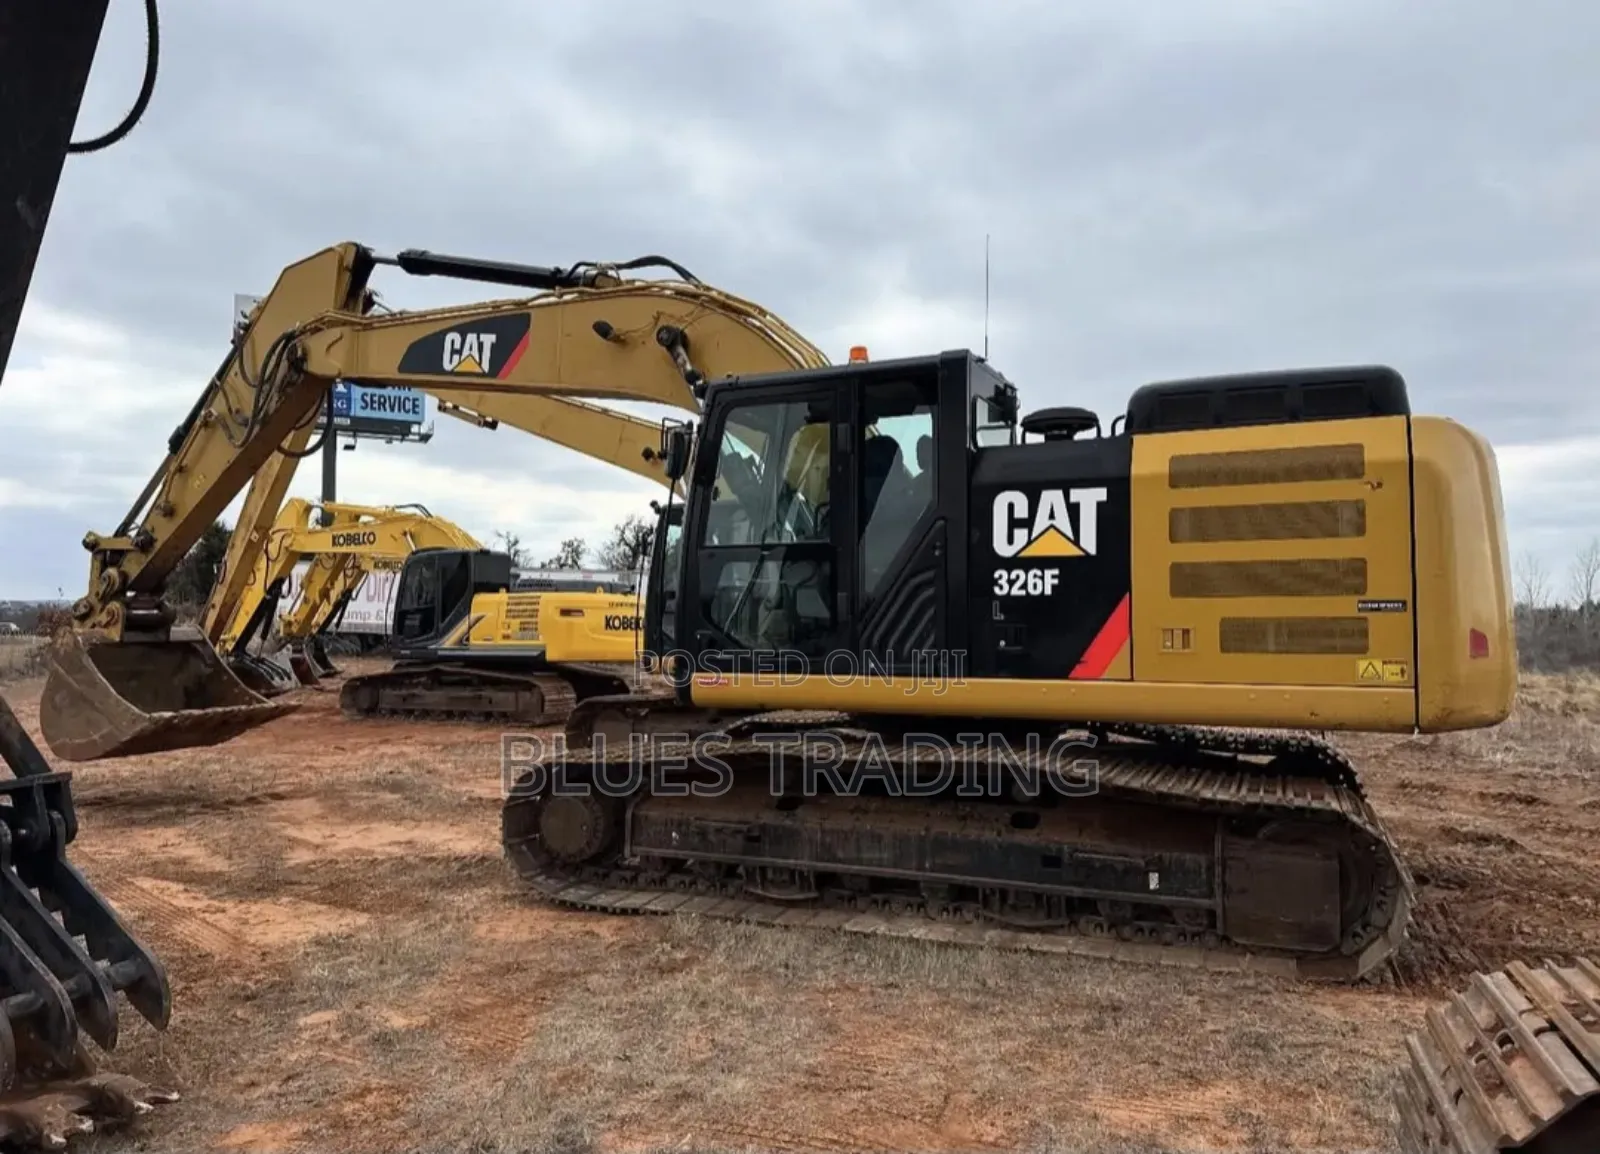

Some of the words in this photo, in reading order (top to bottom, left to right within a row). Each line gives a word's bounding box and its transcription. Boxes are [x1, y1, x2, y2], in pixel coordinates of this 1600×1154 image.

[443, 331, 497, 374] CAT
[360, 392, 420, 416] SERVICE
[993, 487, 1108, 558] CAT
[331, 531, 377, 548] KOBELCO
[993, 568, 1060, 596] 326F
